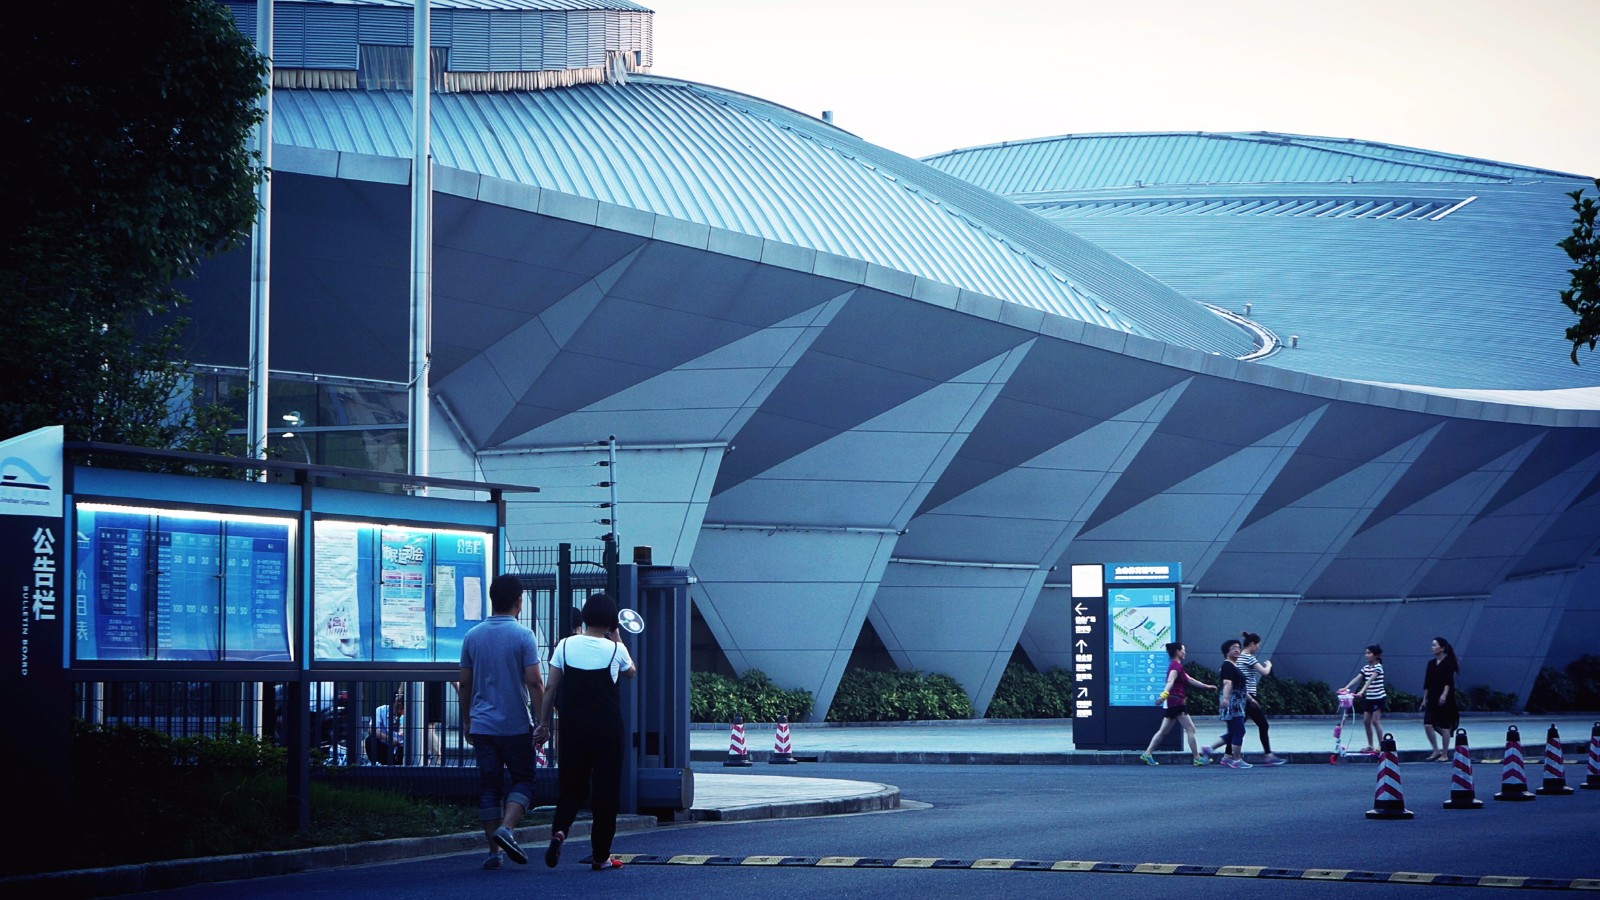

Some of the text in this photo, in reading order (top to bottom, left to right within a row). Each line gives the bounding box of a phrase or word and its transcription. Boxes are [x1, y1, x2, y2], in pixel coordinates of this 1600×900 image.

[130, 547, 139, 557] 30
[457, 538, 482, 555] 公告栏
[174, 555, 182, 564] 50
[201, 556, 209, 565] 30
[241, 559, 250, 567] 30
[32, 527, 56, 621] 公告栏
[129, 583, 138, 592] 40
[173, 604, 182, 613] 100
[186, 604, 196, 613] 100
[201, 605, 208, 614] 40
[240, 606, 248, 615] 50
